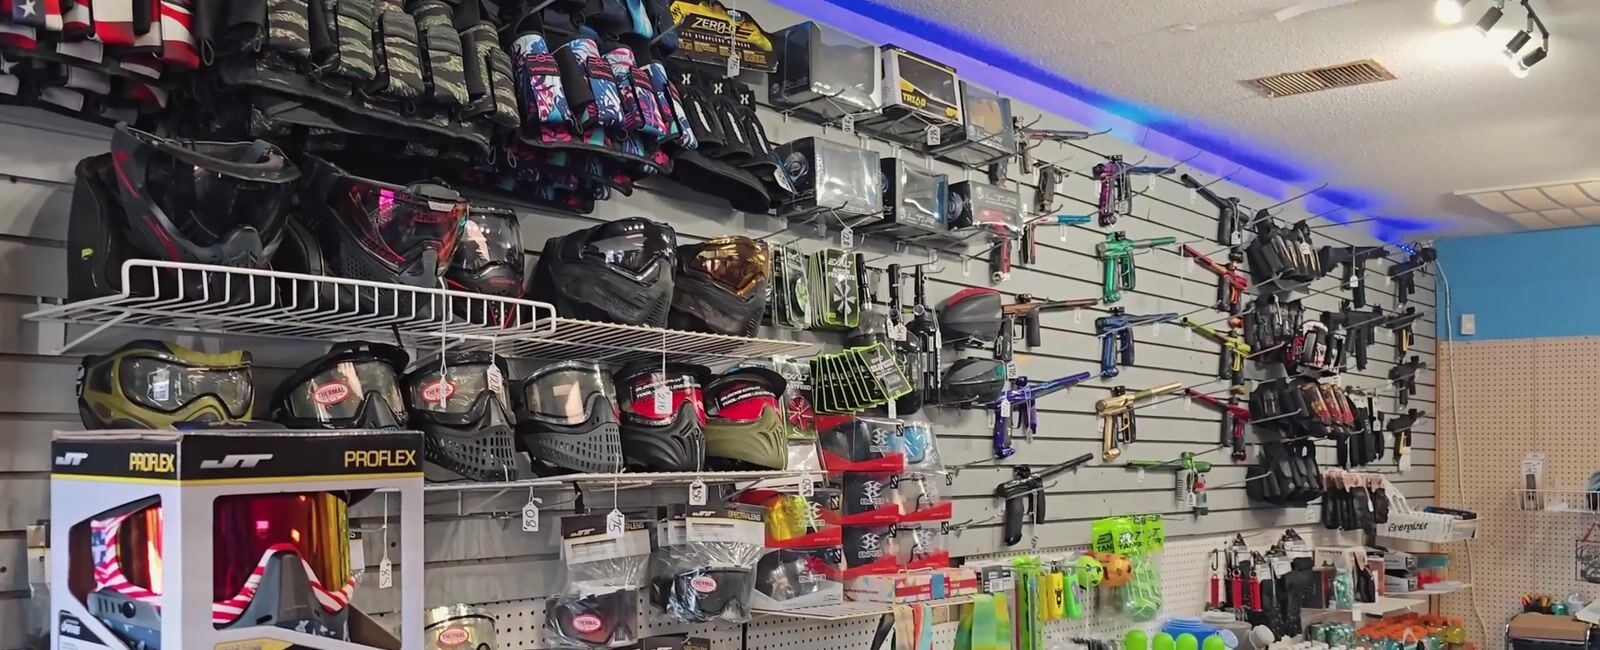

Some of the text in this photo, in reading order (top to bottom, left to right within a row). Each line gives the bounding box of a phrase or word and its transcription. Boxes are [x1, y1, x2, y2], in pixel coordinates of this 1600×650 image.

[902, 92, 927, 107] TRIAD
[317, 385, 349, 399] THERMAL
[129, 452, 174, 472] PROFLEX
[344, 450, 416, 468] PROFLEX
[1388, 522, 1428, 533] Energizer
[693, 580, 714, 588] THERMAL
[576, 618, 599, 628] THERMAL
[441, 631, 467, 641] THERMAL
